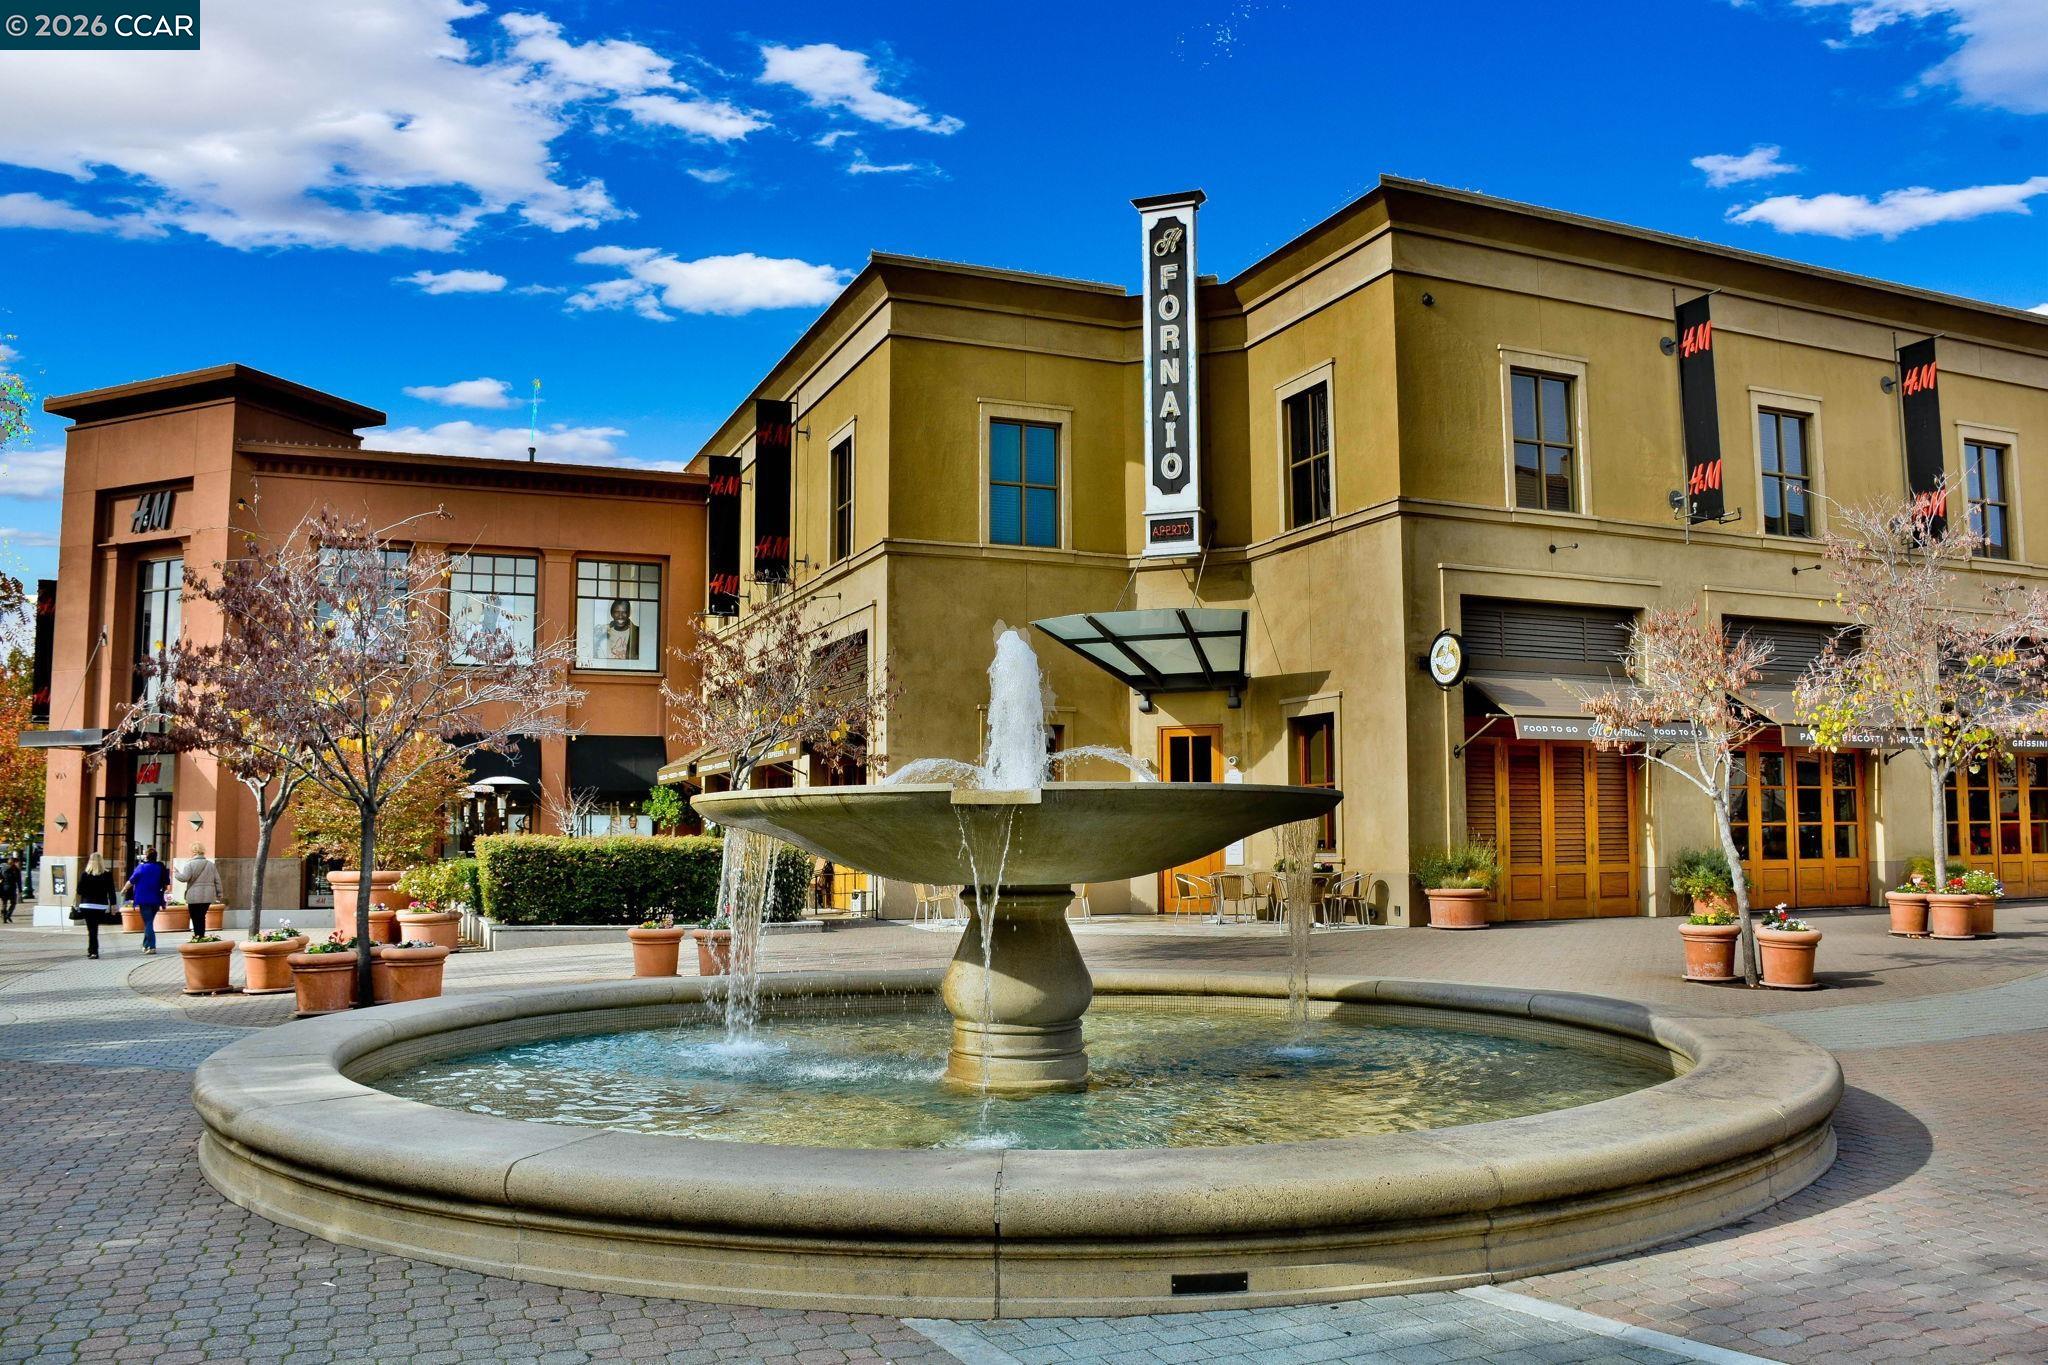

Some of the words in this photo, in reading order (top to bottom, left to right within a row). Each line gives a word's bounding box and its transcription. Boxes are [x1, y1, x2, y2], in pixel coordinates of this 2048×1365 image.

[1680, 320, 1712, 358] H&M
[1158, 263, 1183, 480] FORNAIO
[1903, 361, 1936, 396] H&M
[709, 474, 740, 497] H&M
[1689, 458, 1722, 495] H&M
[131, 490, 171, 534] H&M
[1152, 522, 1191, 537] APERTO
[755, 535, 789, 560] H&M
[709, 573, 739, 594] H&M
[1523, 724, 1549, 733] FOOD
[1550, 725, 1563, 733] TO
[1654, 728, 1677, 736] FOOD
[1900, 735, 1925, 744] PIZZA
[2012, 740, 2048, 748] GRISSINI
